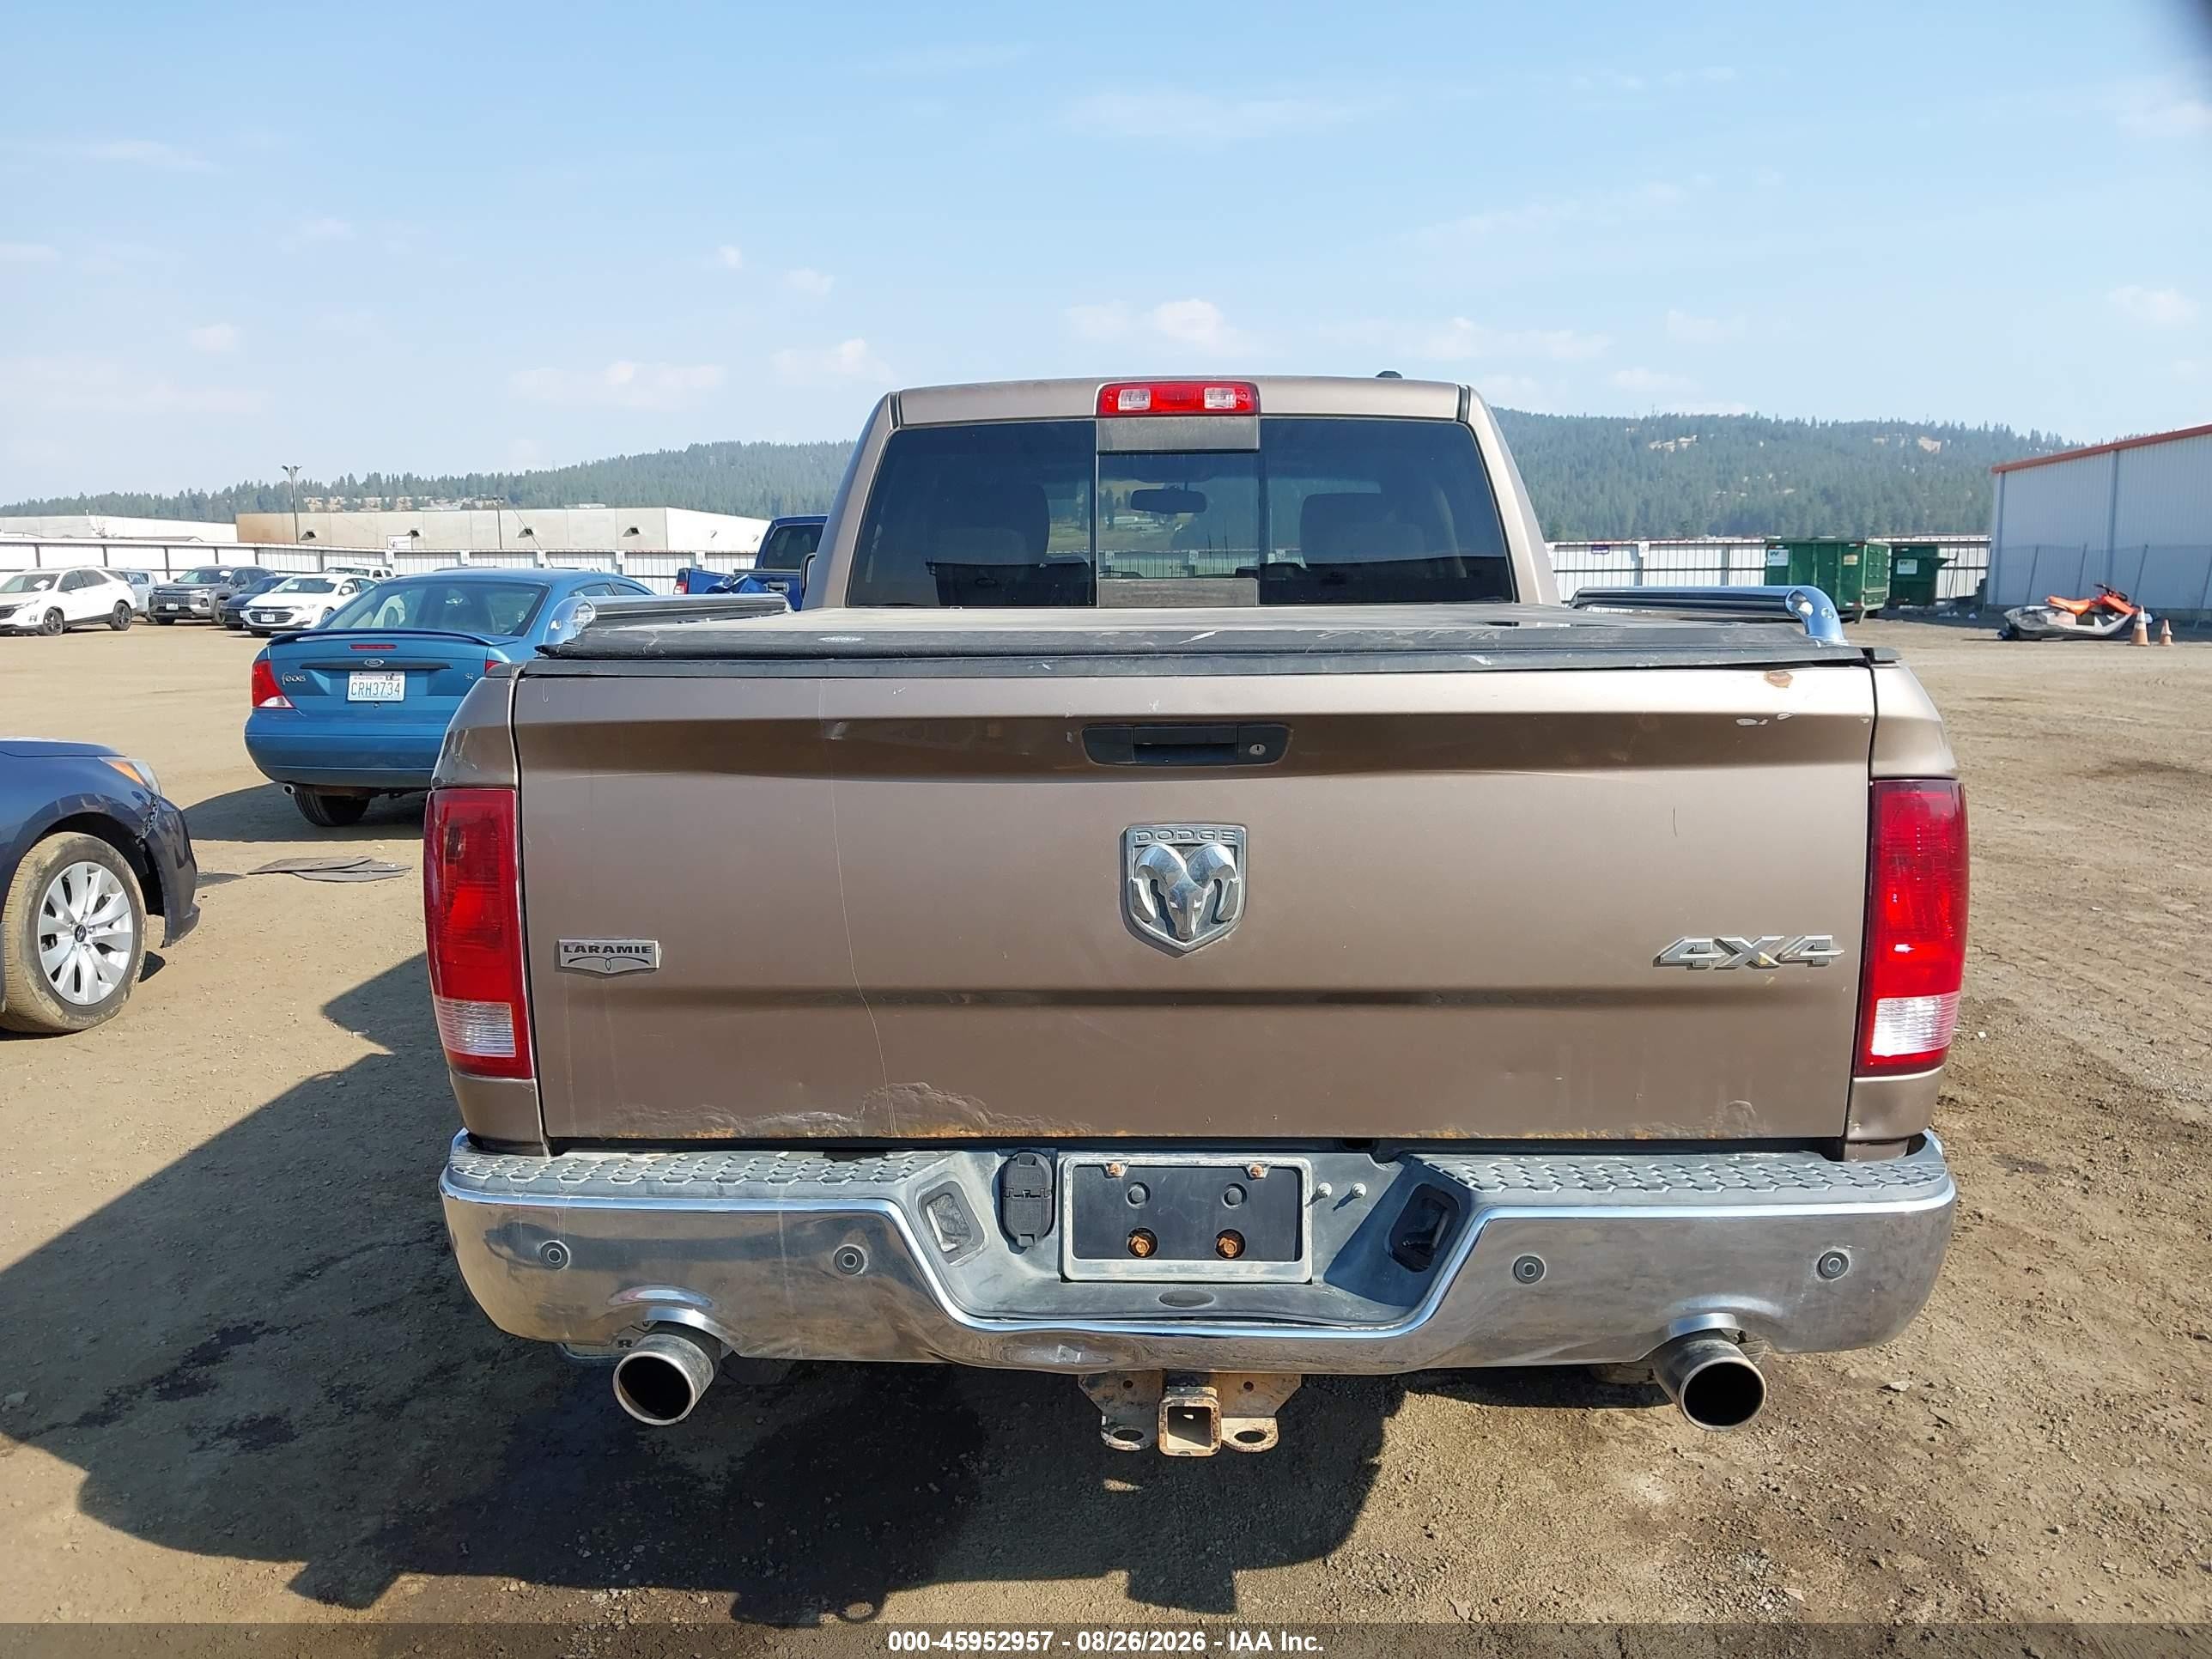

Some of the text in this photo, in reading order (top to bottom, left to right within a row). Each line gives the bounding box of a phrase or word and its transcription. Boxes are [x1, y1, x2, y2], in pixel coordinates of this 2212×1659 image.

[350, 682, 401, 696] CRH3734
[1134, 829, 1237, 843] DODGE
[563, 945, 653, 954] LARAMIE
